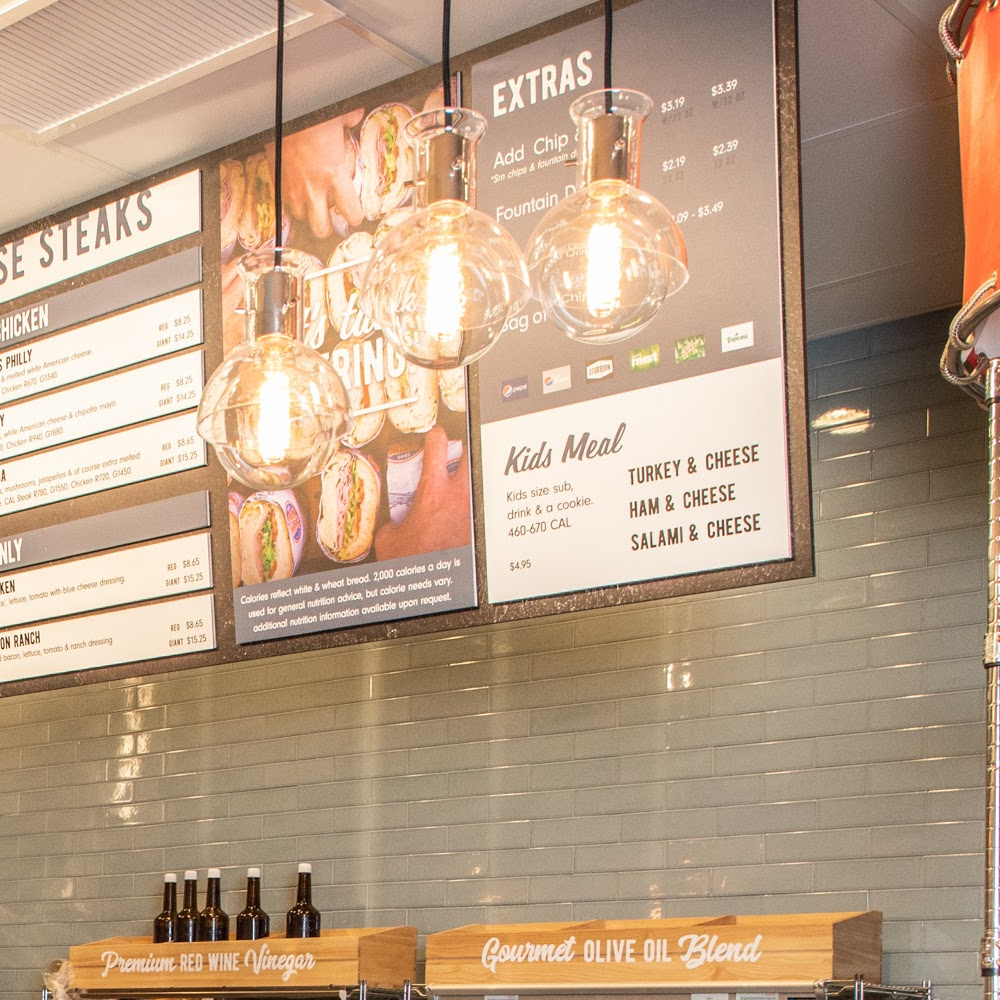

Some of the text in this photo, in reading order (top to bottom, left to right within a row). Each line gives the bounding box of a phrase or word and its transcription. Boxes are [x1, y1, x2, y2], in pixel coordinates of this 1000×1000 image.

[492, 50, 593, 118] EXTRAS
[711, 79, 738, 97] $3.39
[661, 97, 685, 113] $3.19
[494, 134, 568, 169] Add Chip
[713, 139, 738, 157] $2.39
[662, 156, 686, 172] $2.19
[495, 193, 559, 223] Fountain
[698, 201, 723, 218] $3.49
[39, 189, 153, 269] STEAKS
[727, 333, 748, 344] Tropicana
[6, 349, 32, 369] PHILLY
[589, 362, 612, 375] STUBBORN
[631, 351, 658, 368] mist
[513, 383, 528, 394] pepsi
[504, 422, 627, 476] Kids Meal
[628, 444, 759, 485] TURKEY & CHEESE
[507, 481, 574, 502] Kids size sub,
[630, 483, 736, 518] HAM & CHEESE
[508, 496, 594, 520] drink & a cookie.
[508, 517, 571, 538] 460-670 CAL
[631, 513, 761, 551] SALAMI & CHEESE
[510, 560, 532, 572] $4.95
[241, 558, 460, 605] Calories reflect white & wheat bread. 2,000 calories a day is
[248, 577, 452, 619] used for general nutrition advice, but calorie needs vary.
[253, 592, 452, 632] additional nutrition information available upon request.
[171, 619, 203, 632] REG $8.65
[3, 651, 21, 662] bacon,
[23, 647, 41, 658] lettuce,
[43, 645, 63, 655] tomato
[65, 642, 69, 650] &
[71, 640, 86, 650] ranch
[88, 635, 112, 647] dressing
[14, 631, 40, 647] RANCH
[169, 634, 207, 647] GIANT $15.25
[101, 943, 316, 981] Premium RED WINE Vinegar
[481, 934, 763, 974] Gourmet OLIVE OIL Blend
